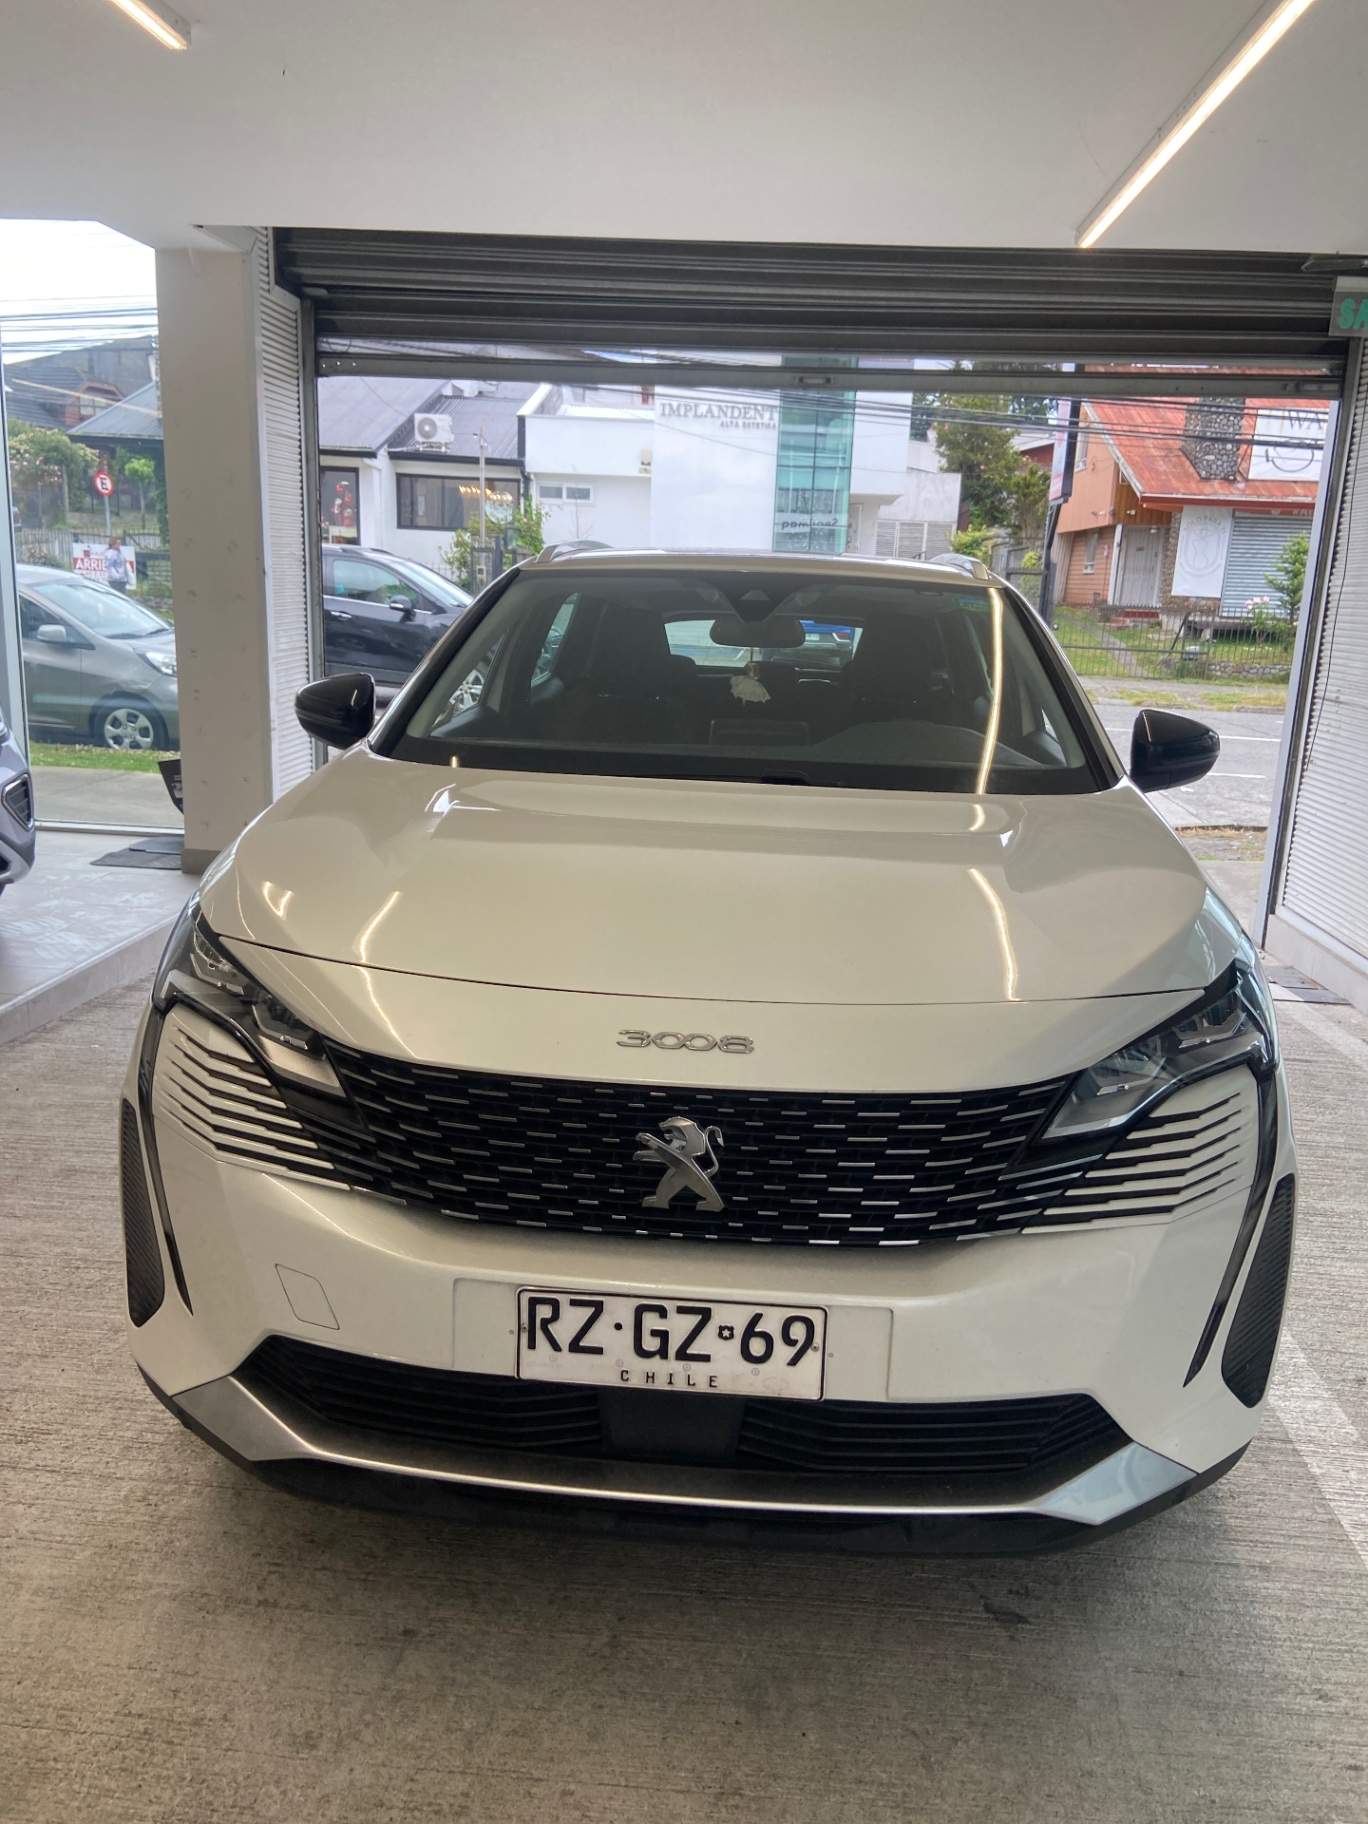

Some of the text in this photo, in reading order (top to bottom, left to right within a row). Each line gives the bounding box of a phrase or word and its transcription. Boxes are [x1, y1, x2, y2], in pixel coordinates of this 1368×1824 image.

[660, 402, 778, 421] IMPLANDENT
[720, 420, 739, 429] ALTA
[100, 478, 109, 490] E
[616, 1029, 755, 1054] 3008
[620, 1369, 718, 1388] CHILE
